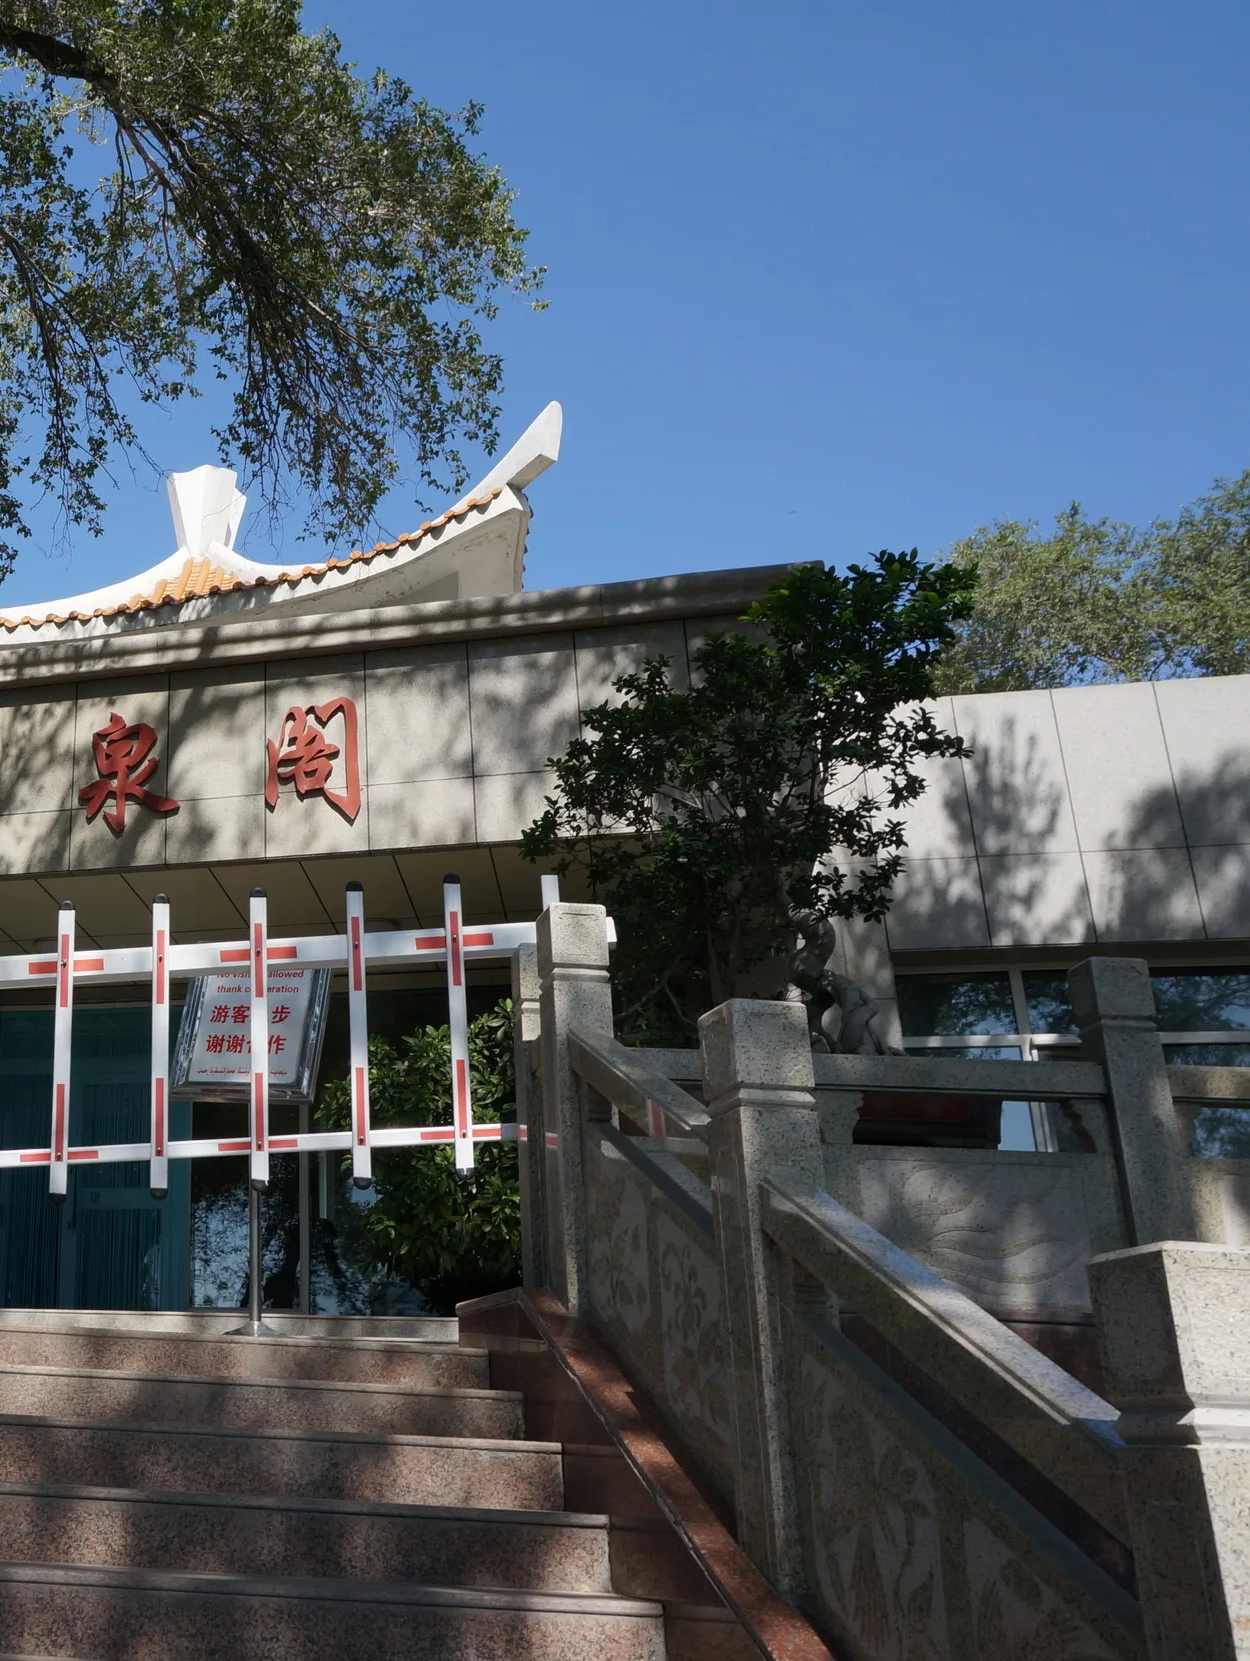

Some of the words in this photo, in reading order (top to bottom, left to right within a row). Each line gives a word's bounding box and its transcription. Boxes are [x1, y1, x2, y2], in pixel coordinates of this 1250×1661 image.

[268, 969, 304, 979] allowed
[217, 984, 242, 993] thank
[244, 984, 299, 993] ceration
[210, 1004, 291, 1024] 游客步
[206, 1034, 287, 1054] 谢谢作
